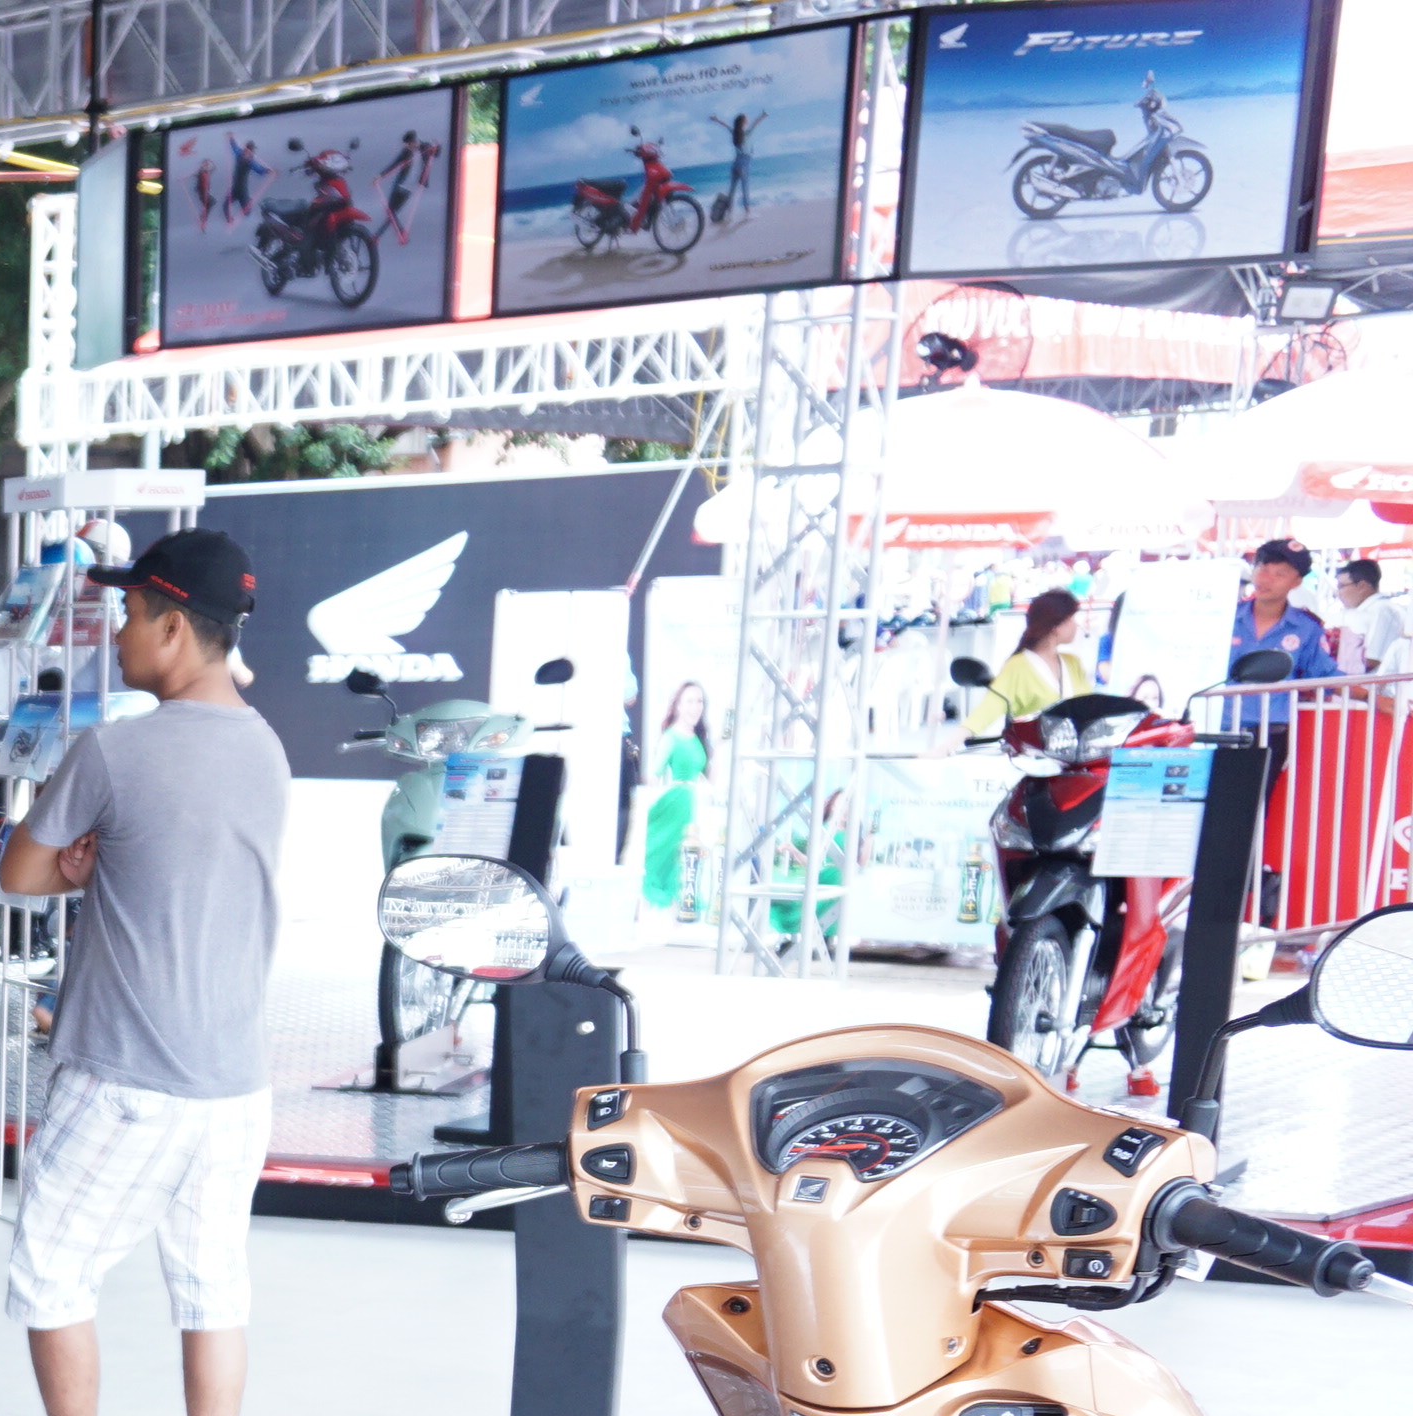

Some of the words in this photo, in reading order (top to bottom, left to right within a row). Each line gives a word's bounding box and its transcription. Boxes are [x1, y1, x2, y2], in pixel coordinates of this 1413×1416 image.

[1013, 30, 1204, 56] FUTURE
[25, 489, 51, 500] HONDA
[147, 484, 185, 496] HONDA
[906, 523, 1019, 542] HONDA
[306, 652, 465, 683] HONDA
[875, 1126, 893, 1134] 80
